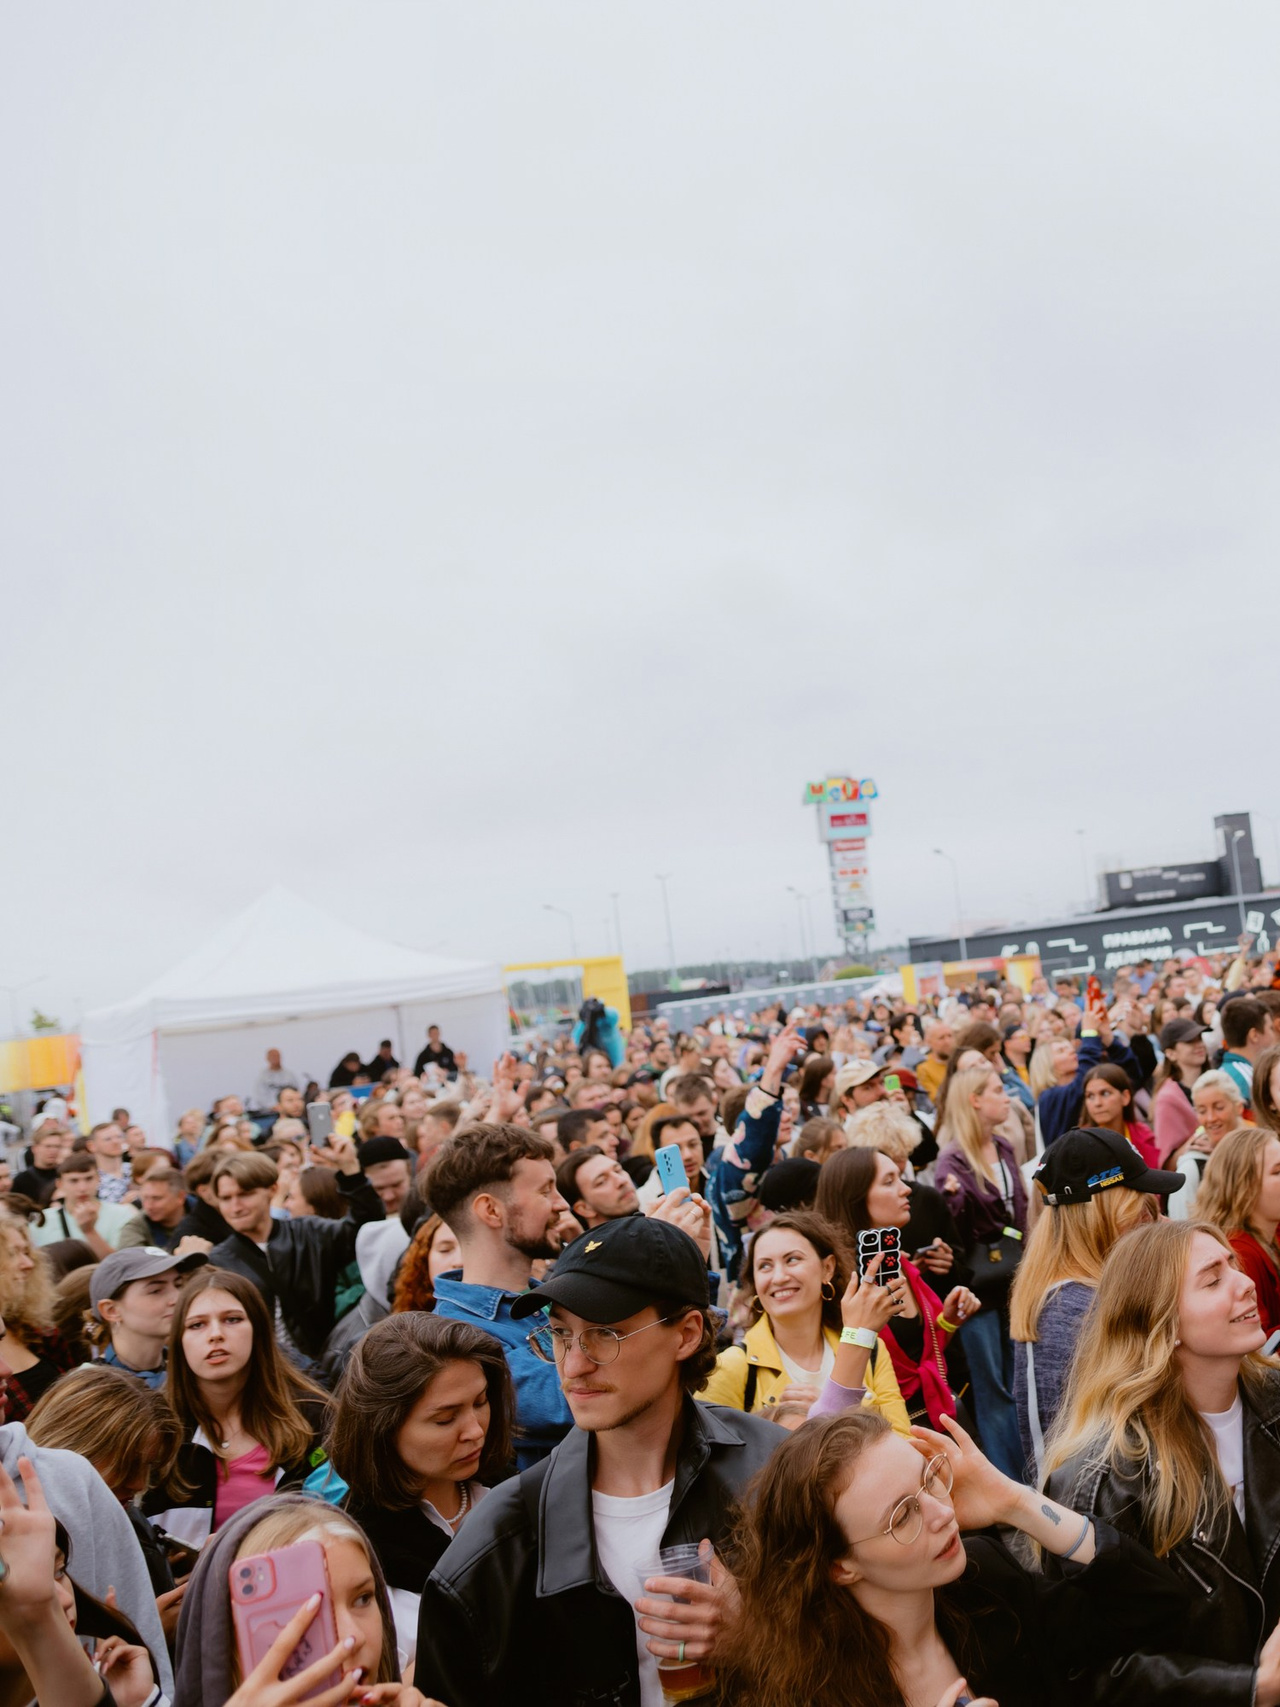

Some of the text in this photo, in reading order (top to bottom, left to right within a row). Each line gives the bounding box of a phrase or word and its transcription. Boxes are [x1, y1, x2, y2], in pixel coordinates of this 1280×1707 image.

[1102, 926, 1172, 949] ПРАВИЛА
[1087, 1166, 1122, 1184] GTR
[1100, 1174, 1124, 1187] NISSAN
